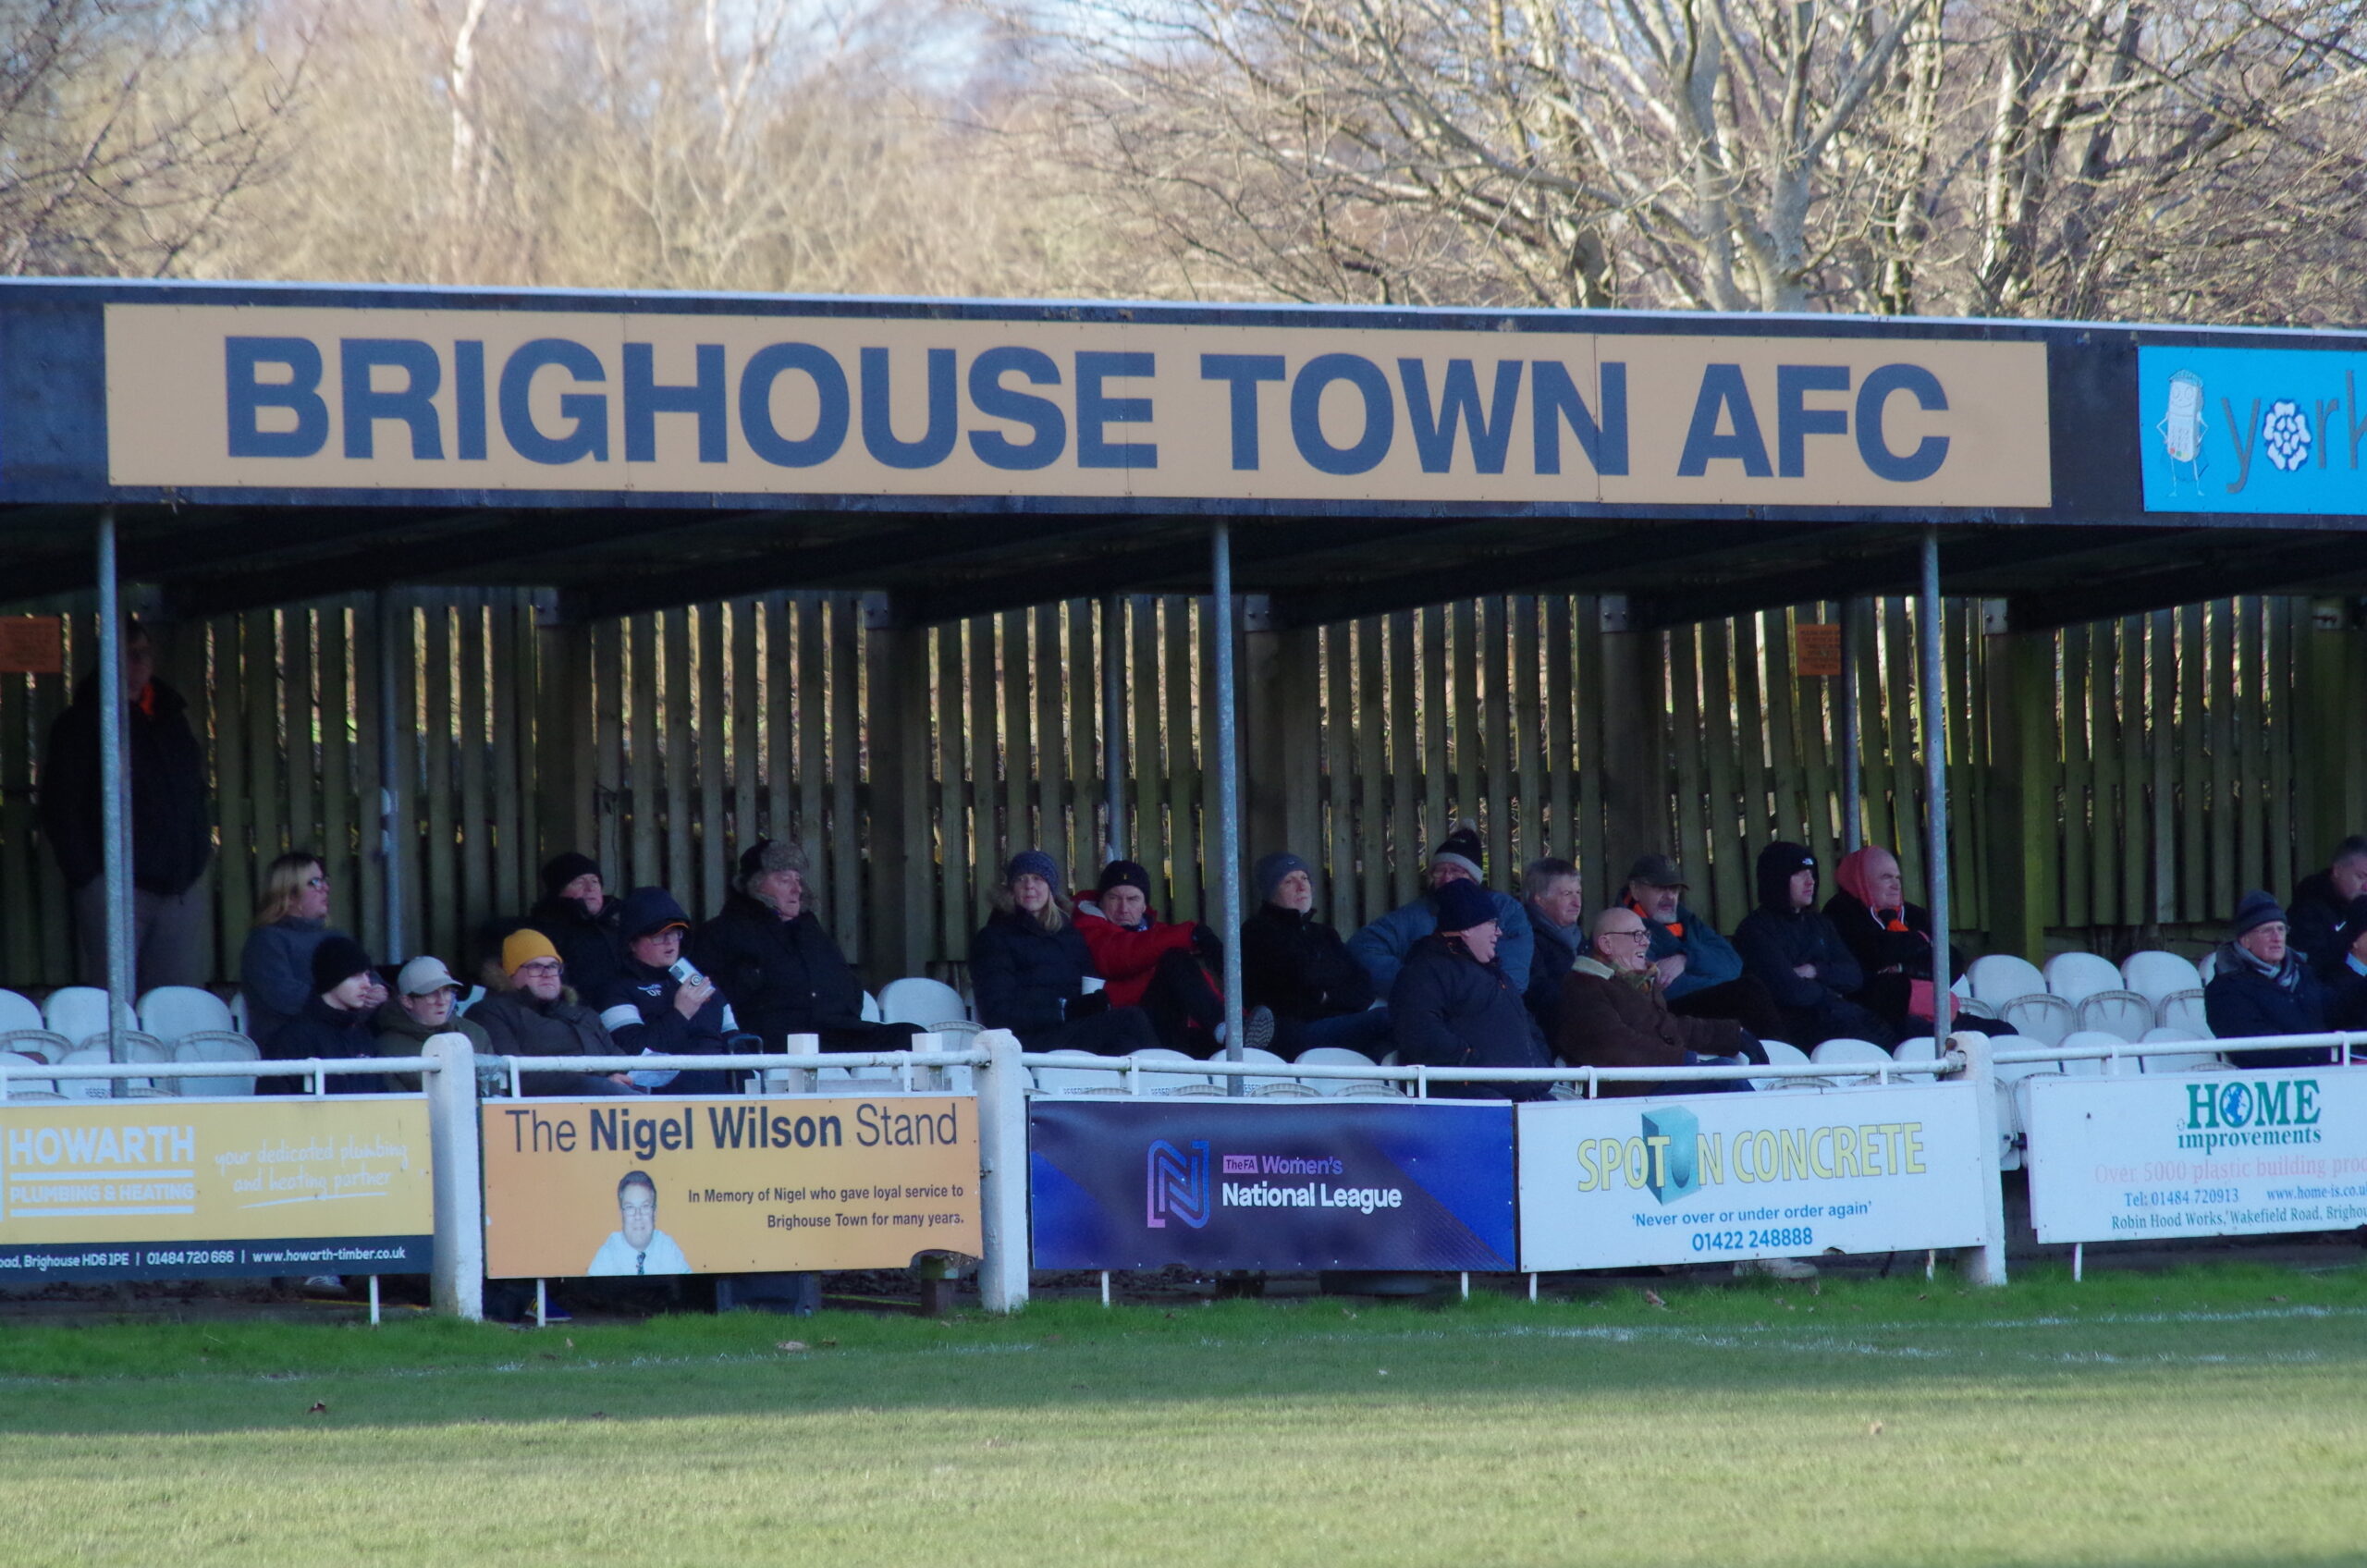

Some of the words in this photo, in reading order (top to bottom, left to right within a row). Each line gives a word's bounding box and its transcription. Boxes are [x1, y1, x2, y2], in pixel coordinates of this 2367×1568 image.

[225, 335, 1158, 471] BRIGHOUSE
[1199, 352, 1630, 476] TOWN
[1676, 362, 1951, 484] AFC
[2186, 1079, 2322, 1129] HOME
[8, 1126, 194, 1165] HOWARTH
[506, 1109, 577, 1153] The
[589, 1108, 693, 1161] Nigel
[708, 1106, 843, 1149] Wilson
[856, 1103, 958, 1146] Stand
[2177, 1124, 2323, 1156] improvements
[215, 1150, 251, 1176] your
[257, 1136, 334, 1163] dedicated
[340, 1134, 409, 1170] plumbing
[1262, 1156, 1343, 1175] Women's
[1732, 1121, 1927, 1183] CONCRETE
[233, 1168, 264, 1192] and
[270, 1165, 327, 1199] heating
[334, 1161, 392, 1194] partner
[2094, 1163, 2138, 1184] Over
[2144, 1160, 2187, 1182] 5000
[2192, 1158, 2250, 1184] plastic
[2256, 1155, 2326, 1179] building
[10, 1185, 100, 1203] PLUMBING
[104, 1184, 117, 1202] &
[119, 1183, 194, 1201] HEATING
[688, 1189, 700, 1203] In
[704, 1189, 754, 1204] Memory
[758, 1188, 770, 1201] of
[774, 1187, 805, 1204] Nigel
[810, 1186, 837, 1200] who
[840, 1188, 869, 1202] gave
[874, 1185, 901, 1201] loyal
[905, 1184, 948, 1197] service
[951, 1184, 963, 1197] to
[1222, 1181, 1316, 1207] National
[1320, 1182, 1402, 1214] League
[2124, 1191, 2148, 1207] Tel:
[2151, 1190, 2189, 1206] 01484
[2194, 1188, 2239, 1205] 720913
[2266, 1182, 2367, 1200] www.home-is.co.u
[767, 1214, 831, 1231] Brighouse
[835, 1213, 867, 1227] Town
[872, 1212, 889, 1225] for
[892, 1214, 925, 1228] many
[927, 1213, 963, 1228] years.
[1682, 1211, 1713, 1225] over
[1719, 1210, 1735, 1222] or
[1738, 1208, 1780, 1222] under
[1784, 1205, 1823, 1219] order
[2112, 1214, 2147, 1231] Robin
[2151, 1212, 2181, 1228] Hood
[2186, 1211, 2226, 1227] Works,
[2230, 1207, 2287, 1225] Wakefield
[2290, 1206, 2323, 1221] Road,
[1691, 1231, 1744, 1252] 01422
[1748, 1227, 1813, 1248] 248888
[24, 1255, 80, 1271] Brighouse
[82, 1255, 106, 1267] HD6
[108, 1253, 129, 1266] 1PE
[147, 1252, 184, 1265] 01484
[186, 1252, 208, 1265] 720
[211, 1250, 234, 1264] 666
[252, 1247, 405, 1263] www.howarth-timber.co.uk
